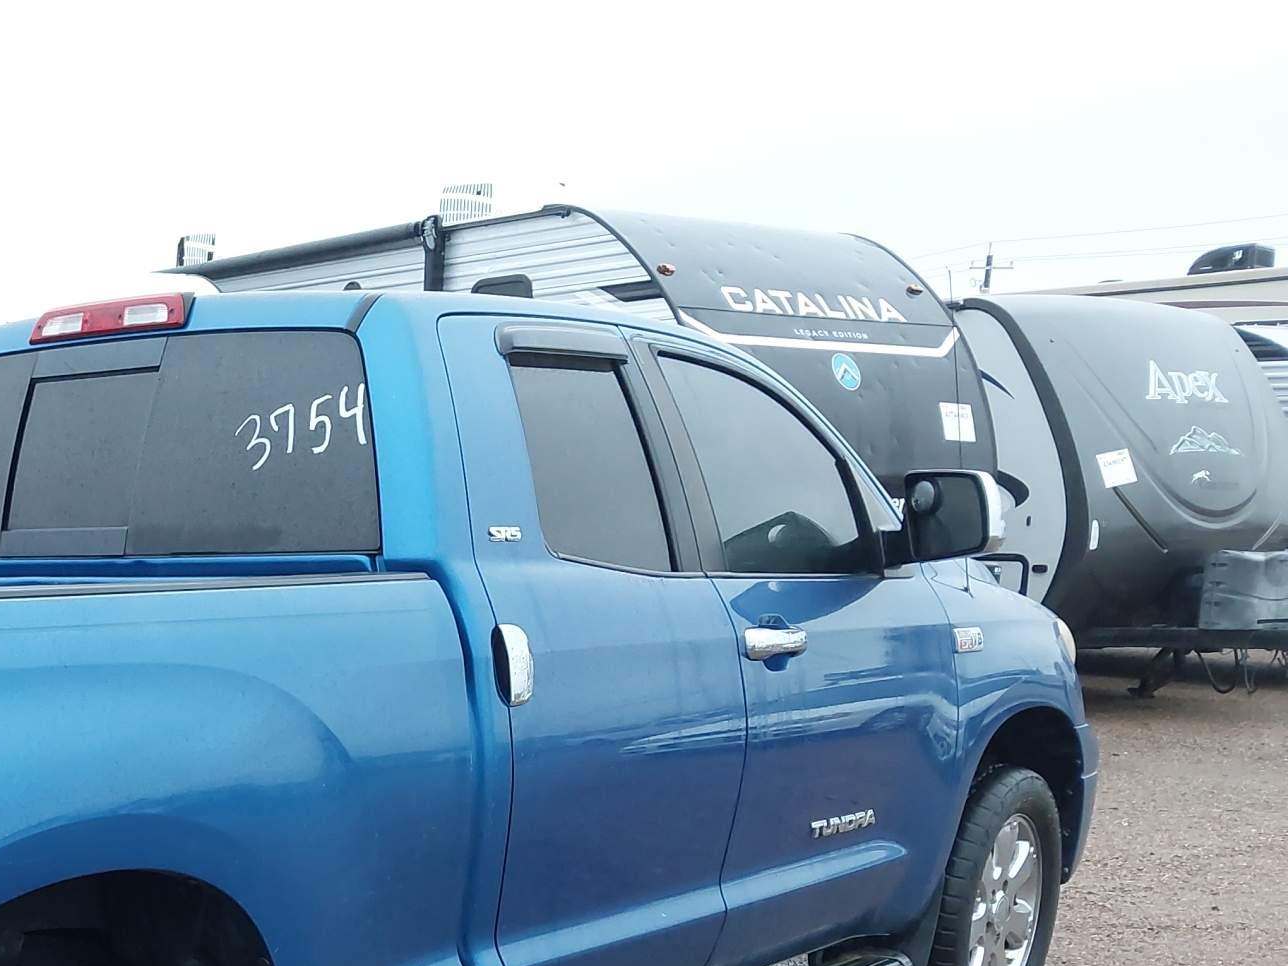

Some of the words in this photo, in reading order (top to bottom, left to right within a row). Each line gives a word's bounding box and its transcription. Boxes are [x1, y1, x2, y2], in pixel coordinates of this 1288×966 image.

[720, 285, 908, 323] CATALINA
[793, 328, 829, 338] LEGACY
[1145, 359, 1229, 404] Apex
[235, 383, 367, 471] 3754
[811, 808, 876, 839] TUNDRA
